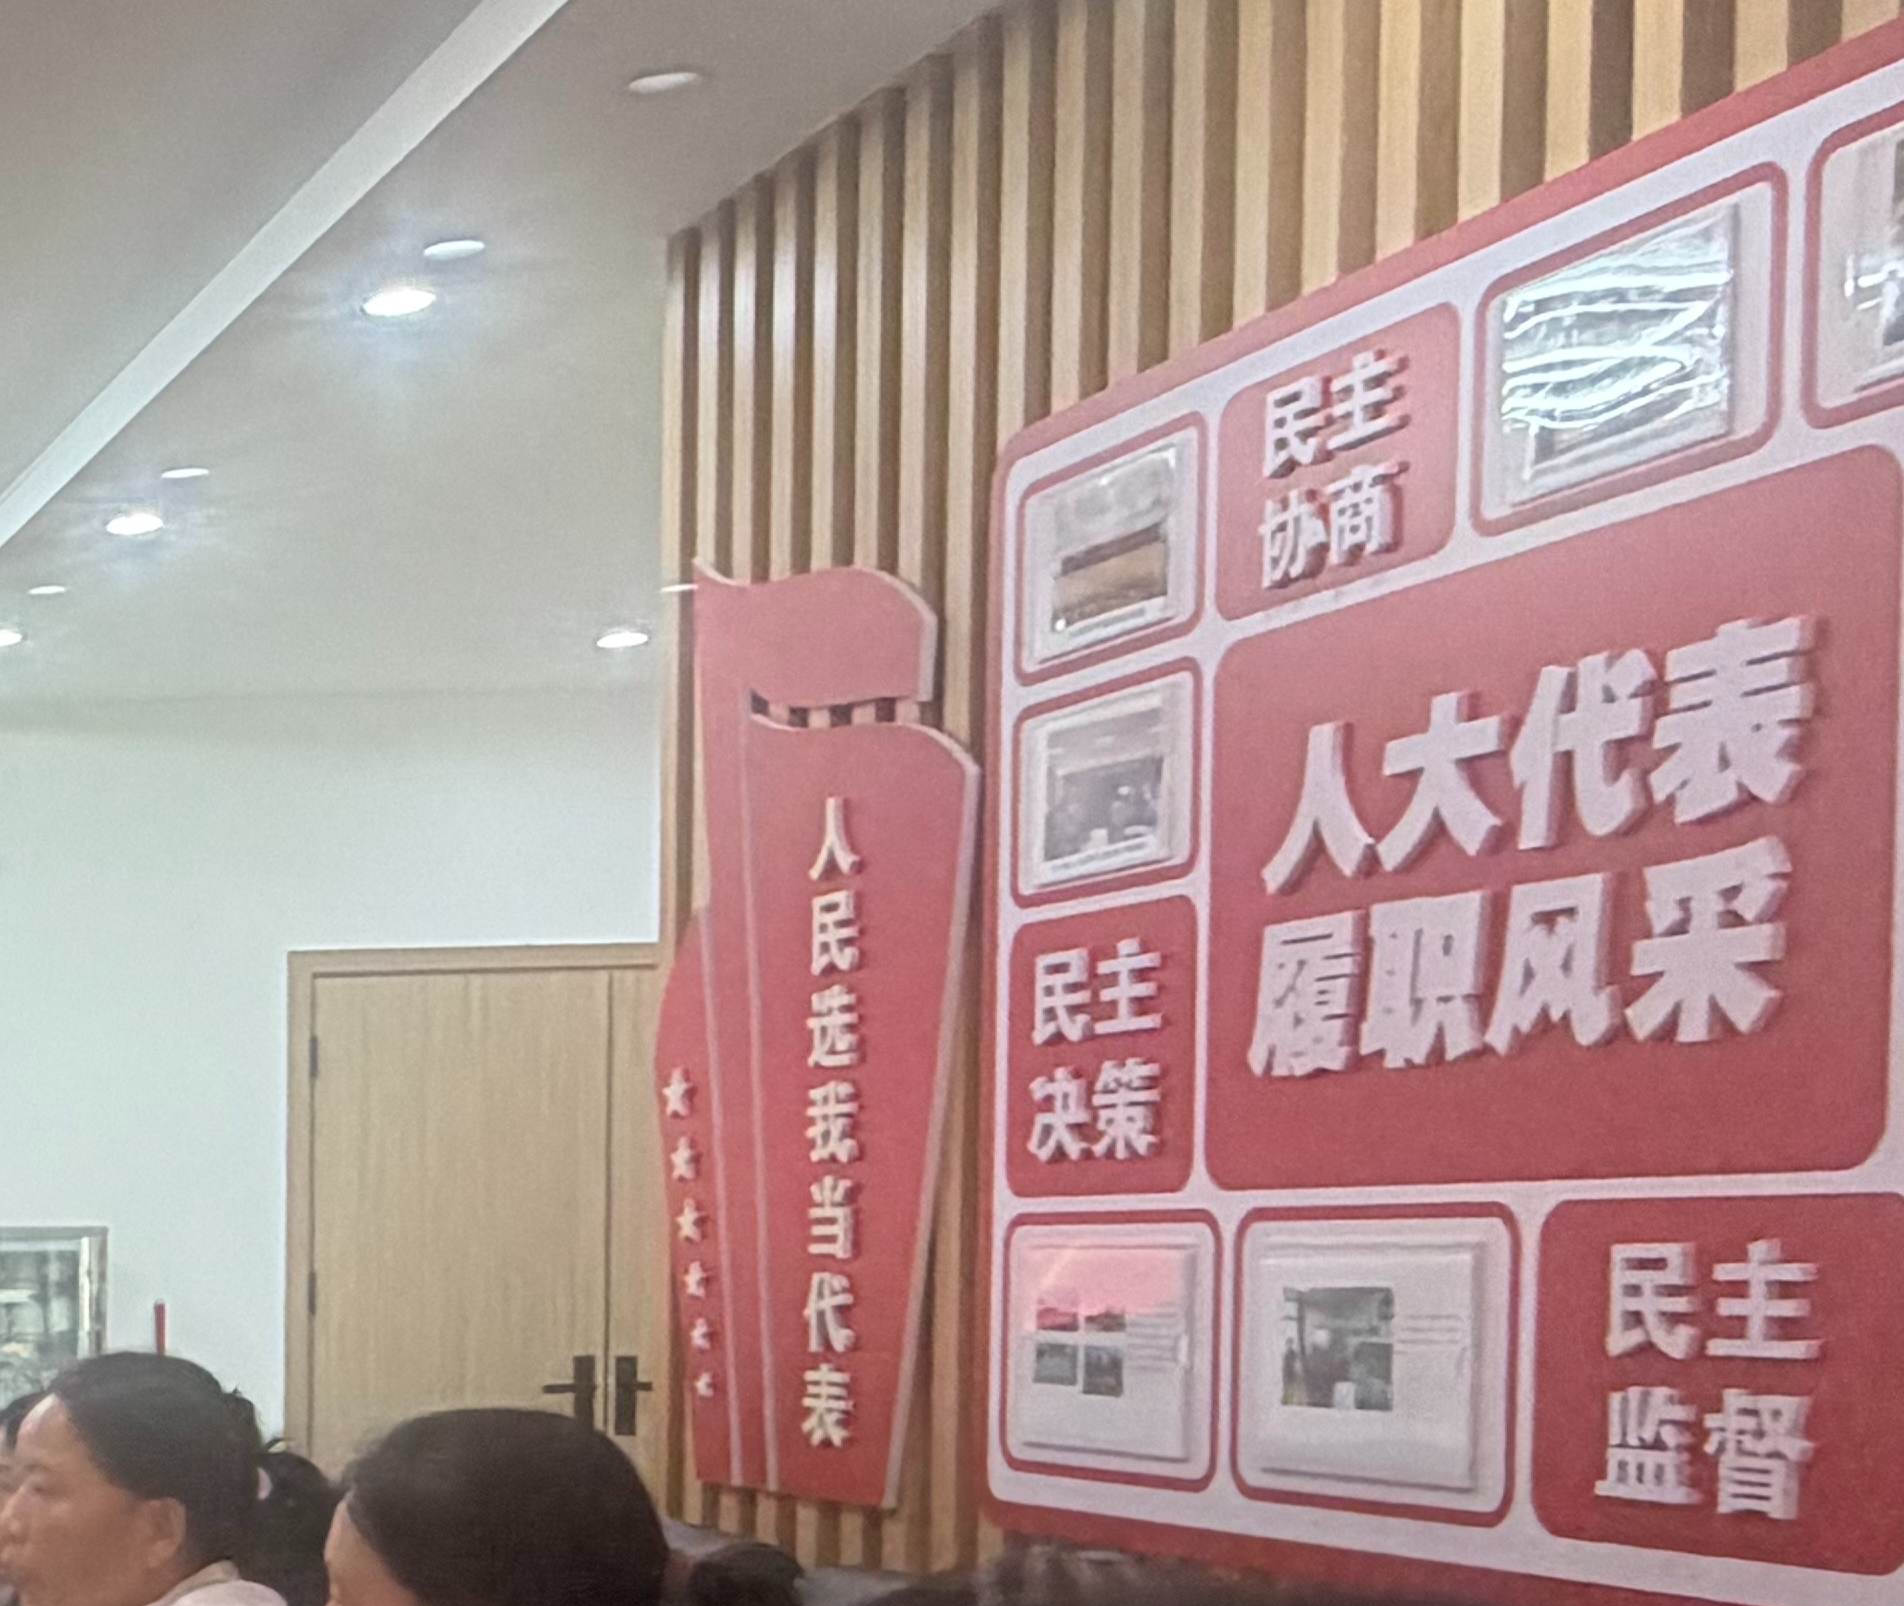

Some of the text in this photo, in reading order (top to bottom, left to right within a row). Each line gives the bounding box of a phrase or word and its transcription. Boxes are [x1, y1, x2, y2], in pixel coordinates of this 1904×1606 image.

[1262, 349, 1410, 480] 民主
[1257, 460, 1403, 590] 协商
[1262, 614, 1824, 893] 人大代表
[1032, 938, 1163, 1046] 民主
[1247, 837, 1793, 1079] 履职风采
[803, 797, 861, 1449] 人民选我当代表
[1027, 1057, 1160, 1163] 决策
[1605, 1239, 1821, 1363] 民主
[1593, 1386, 1815, 1520] 监督
